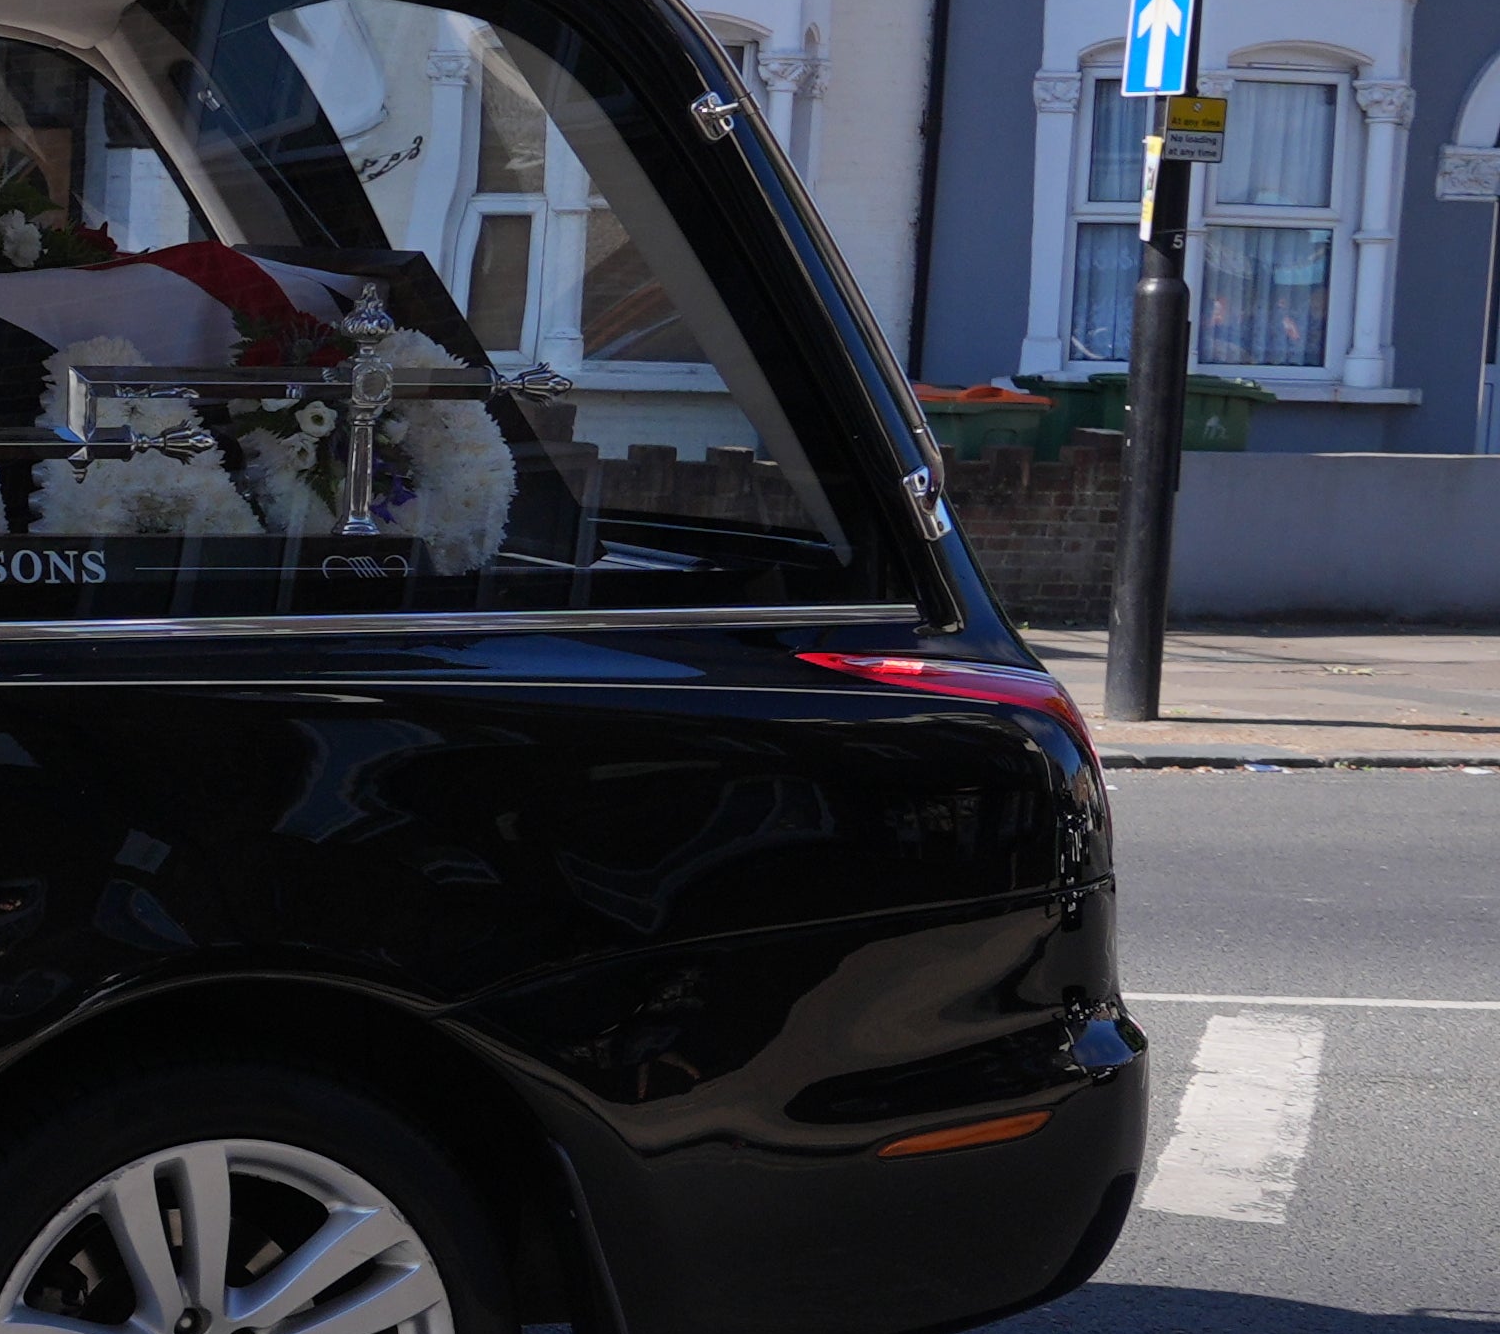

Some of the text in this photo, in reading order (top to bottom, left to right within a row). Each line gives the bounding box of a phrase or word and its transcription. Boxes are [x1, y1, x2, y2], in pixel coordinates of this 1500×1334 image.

[1170, 133, 1217, 146] No loading
[1167, 147, 1217, 157] at any time
[1172, 234, 1184, 249] 5
